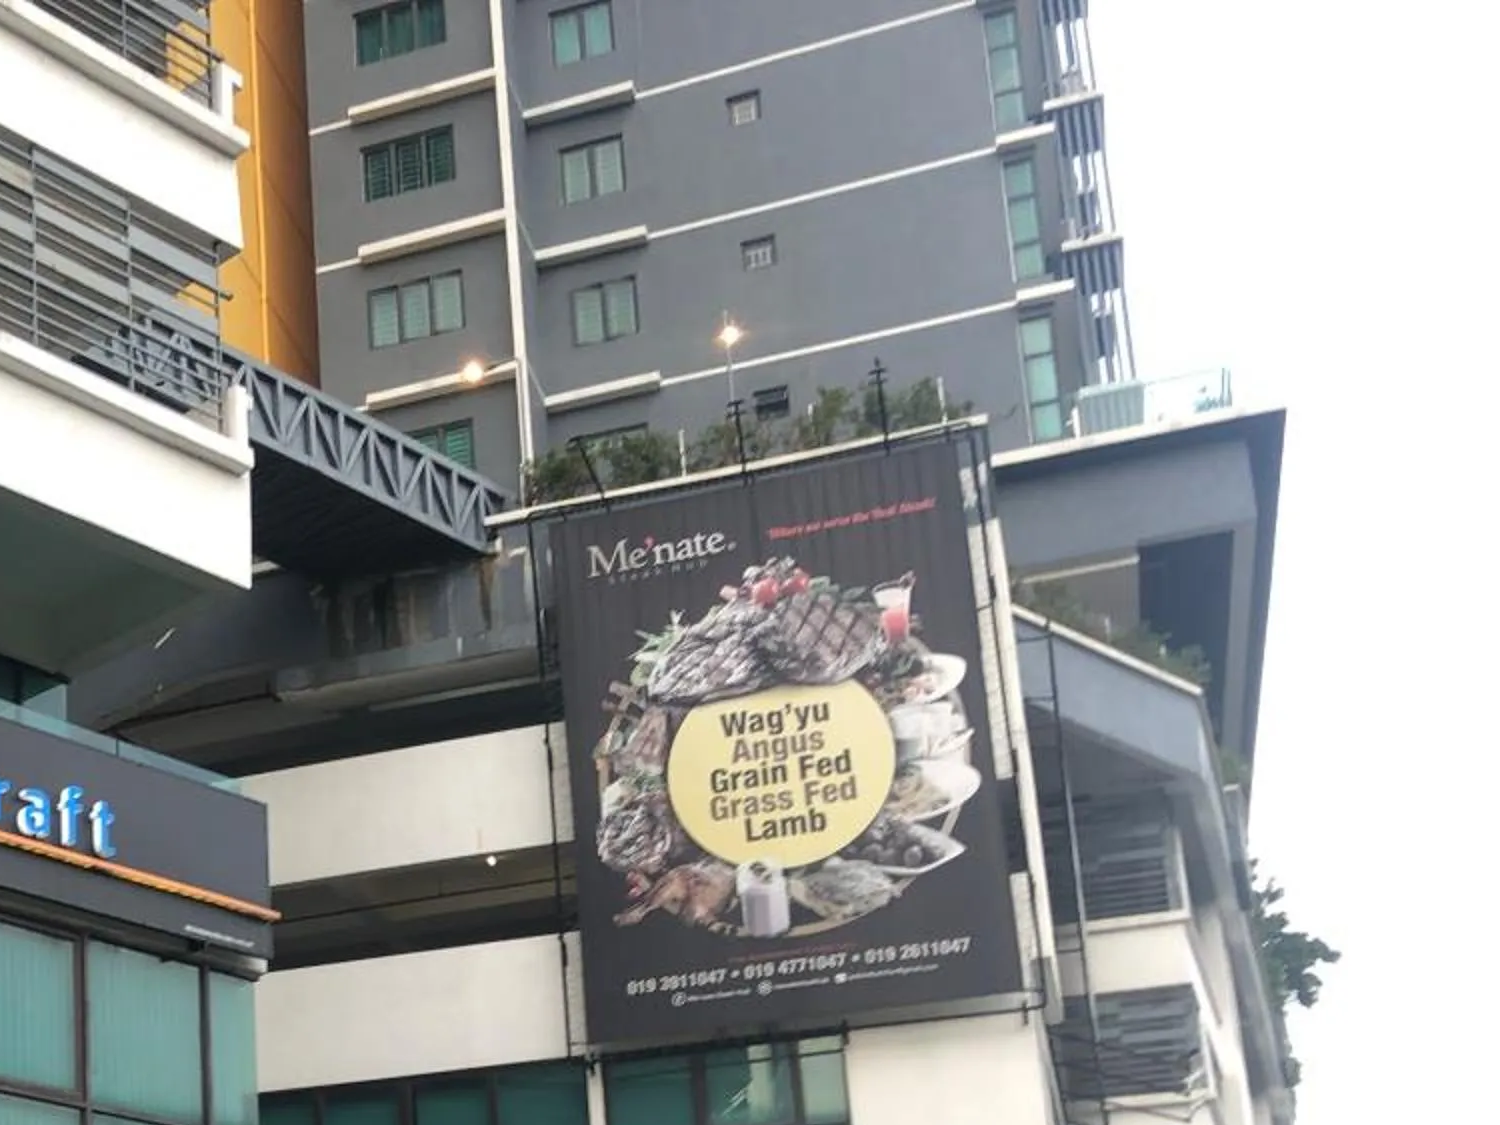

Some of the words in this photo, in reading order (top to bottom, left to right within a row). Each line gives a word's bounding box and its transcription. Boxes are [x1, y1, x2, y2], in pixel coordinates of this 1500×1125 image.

[720, 701, 830, 738] Wag'yu
[731, 727, 825, 765] Angus
[710, 761, 788, 794] Grain
[799, 749, 852, 783] Fed
[709, 788, 793, 821] Grass
[805, 777, 858, 811] Fed
[744, 809, 827, 843] Lamb
